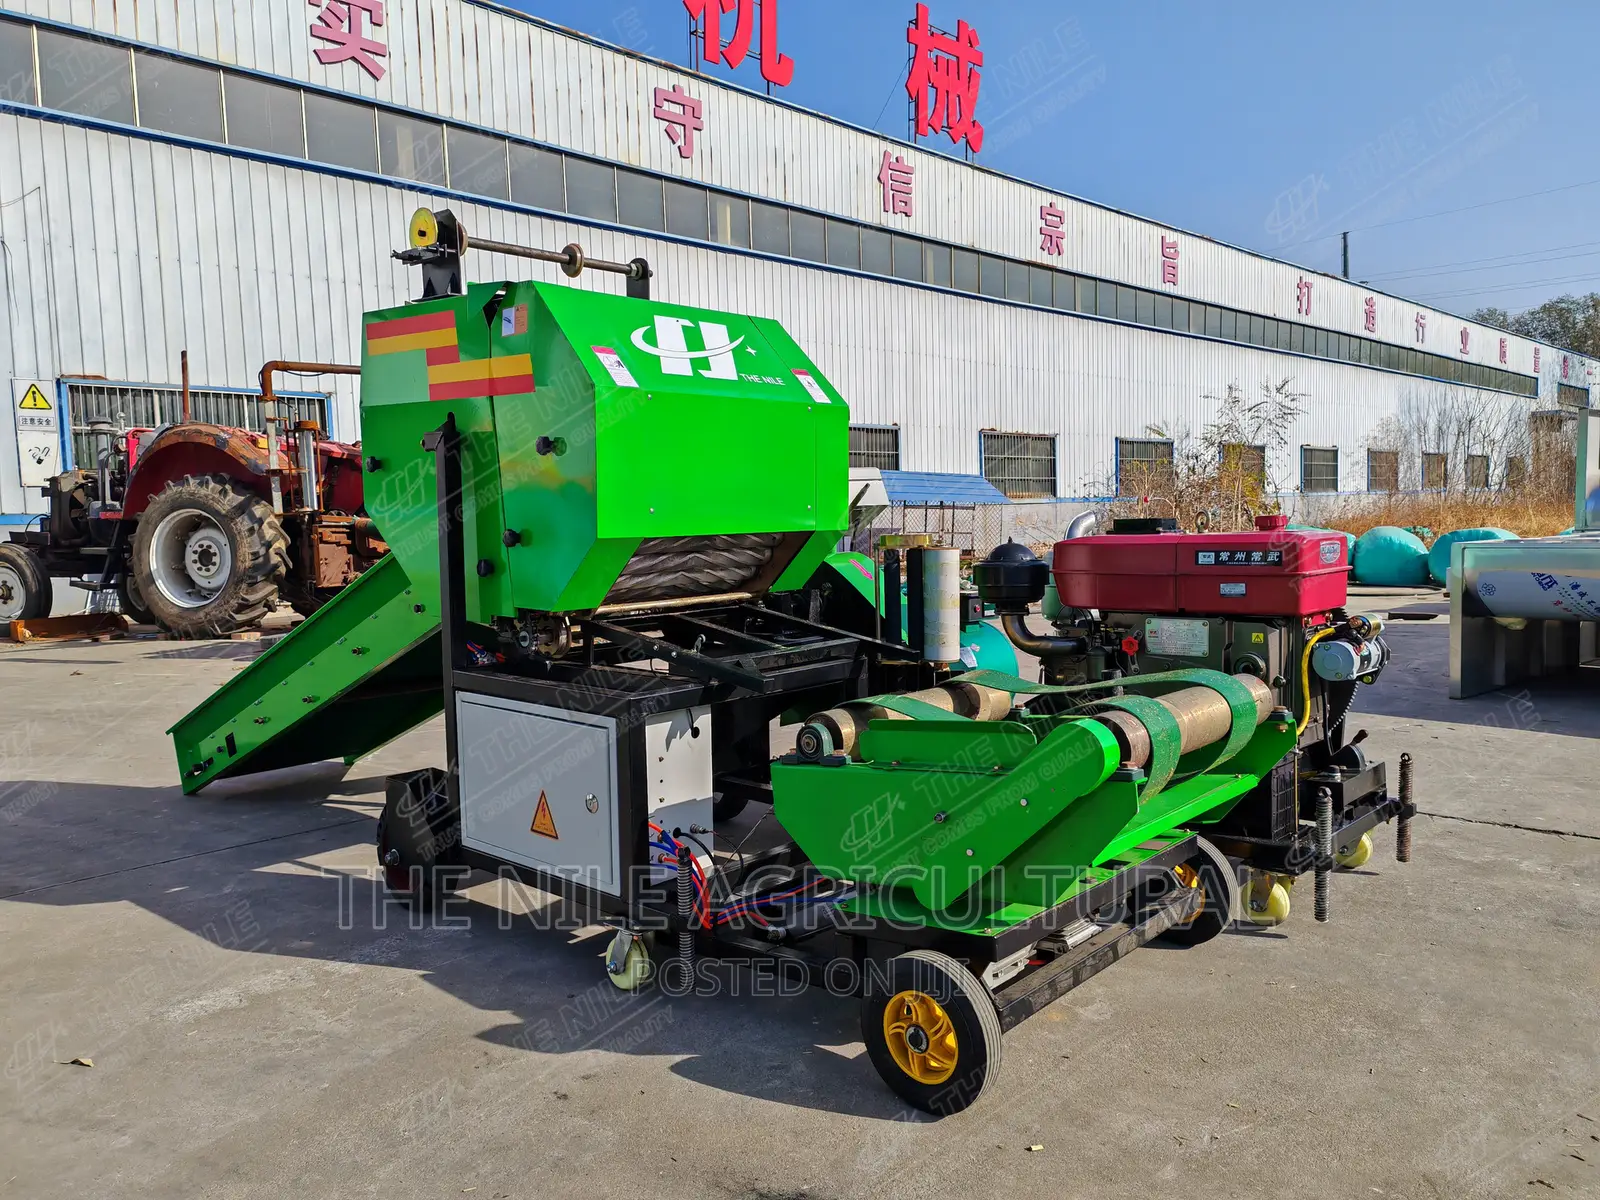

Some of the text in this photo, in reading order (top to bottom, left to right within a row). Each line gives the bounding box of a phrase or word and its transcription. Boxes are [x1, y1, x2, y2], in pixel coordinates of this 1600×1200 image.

[739, 373, 786, 386] THE NILE
[21, 417, 52, 426] 注意安全
[1219, 551, 1280, 562] 常州常武
